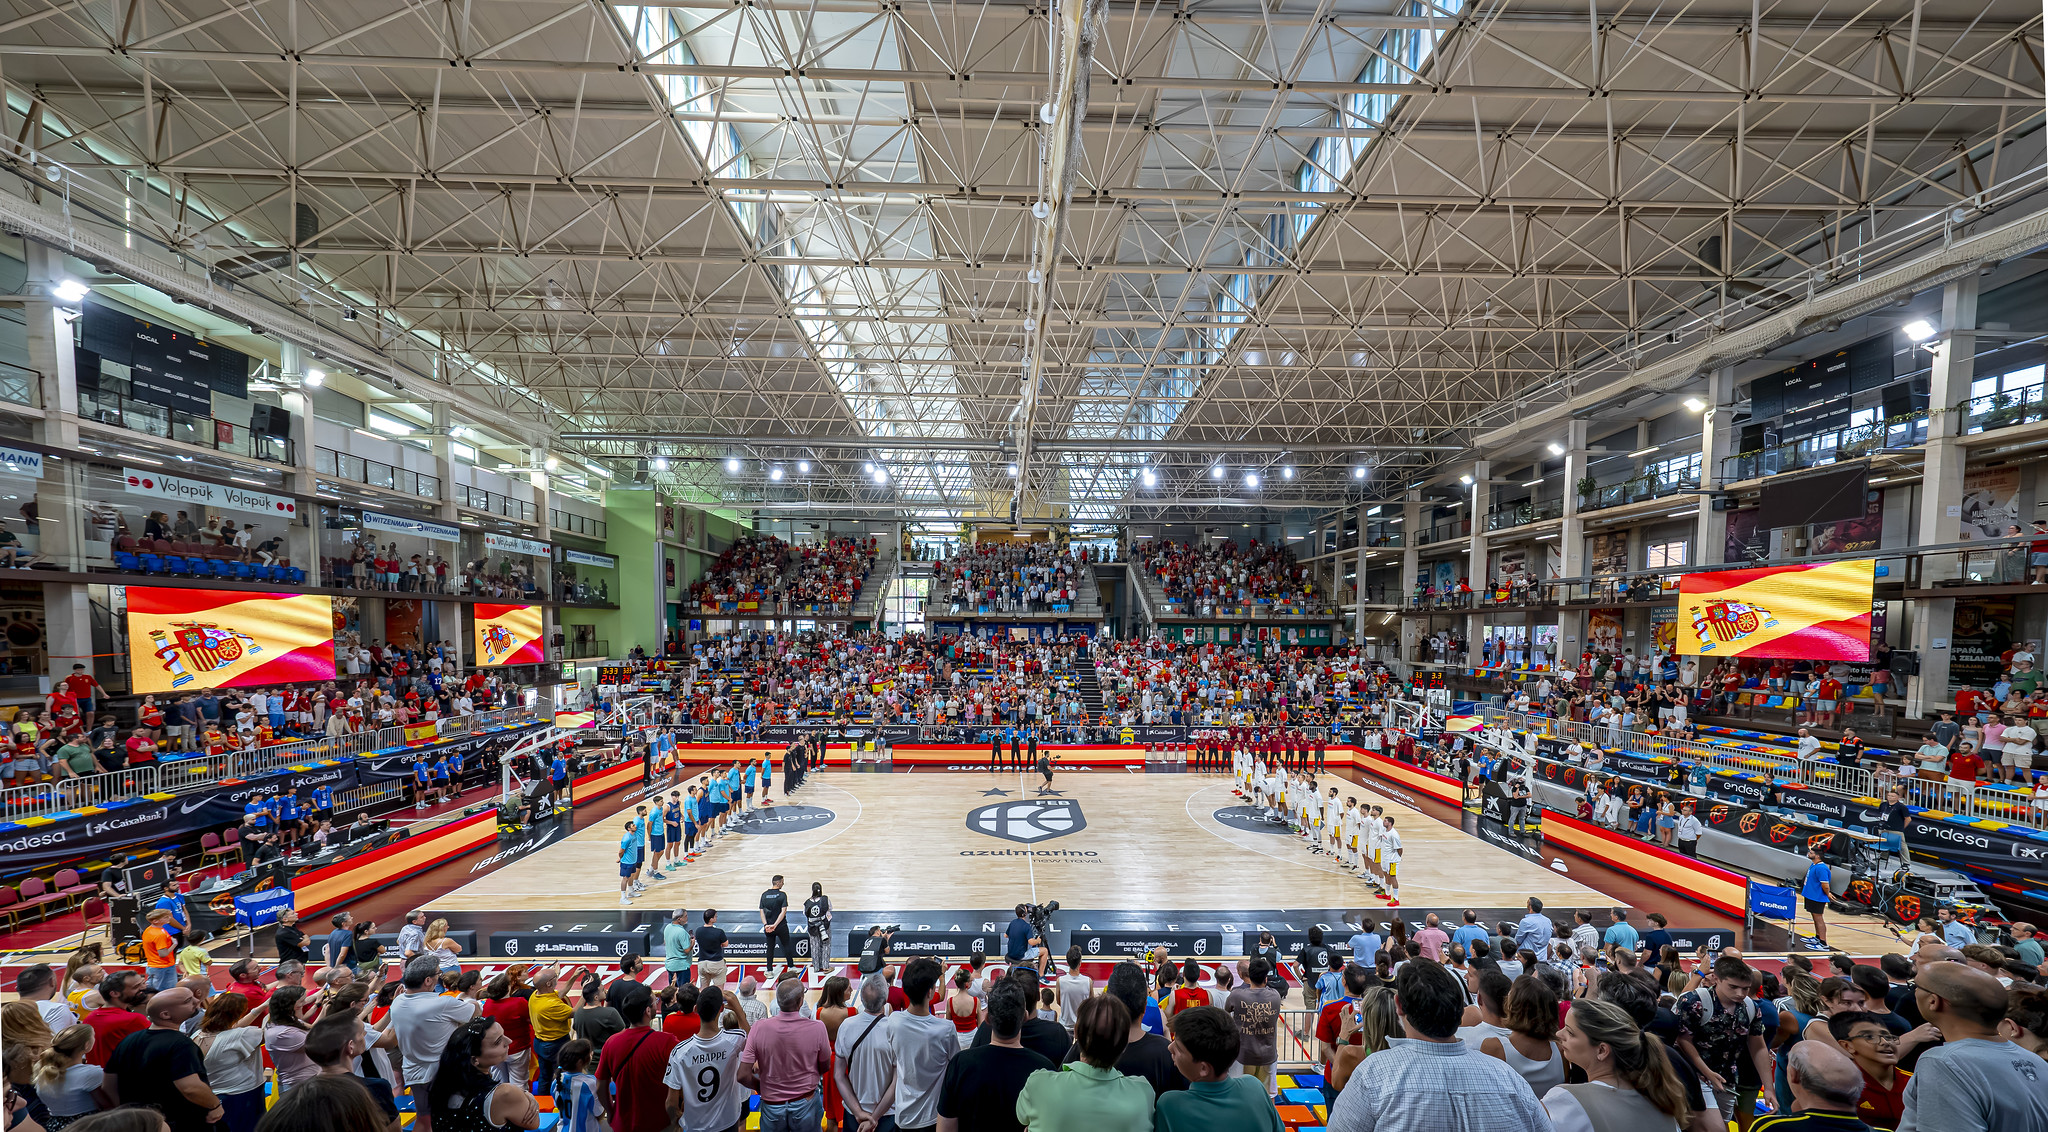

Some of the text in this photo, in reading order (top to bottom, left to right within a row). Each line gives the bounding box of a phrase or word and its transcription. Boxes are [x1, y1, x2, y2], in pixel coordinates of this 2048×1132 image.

[136, 332, 159, 345] LOCAL
[1785, 377, 1802, 387] LOCAL
[158, 476, 272, 511] Volapük Volapük
[372, 515, 414, 528] WITZENMANN
[424, 525, 459, 537] WITZENMANN
[434, 677, 442, 685] 17
[601, 675, 615, 684] 24
[621, 674, 631, 684] 24
[1414, 678, 1423, 688] 24
[1430, 679, 1443, 688] 24
[1628, 762, 1655, 774] CaixaBank
[305, 772, 338, 785] CaixaBank
[1723, 781, 1840, 814] endes CaixaBank
[110, 810, 162, 829] CaixaBank
[1916, 823, 1989, 849] endesa
[1481, 827, 1544, 859] IBERIA
[470, 838, 534, 873] IBERIA
[960, 849, 1098, 857] azulmarino
[256, 903, 289, 917] molten
[1759, 900, 1788, 911] molten
[535, 943, 599, 953] #LaFamilia
[893, 942, 955, 951] #LaFamilia
[1240, 1000, 1272, 1010] Do Good
[1239, 1014, 1252, 1023] The
[1241, 1026, 1253, 1035] The
[691, 1050, 727, 1065] MBAPPÉ
[697, 1066, 720, 1102] 9
